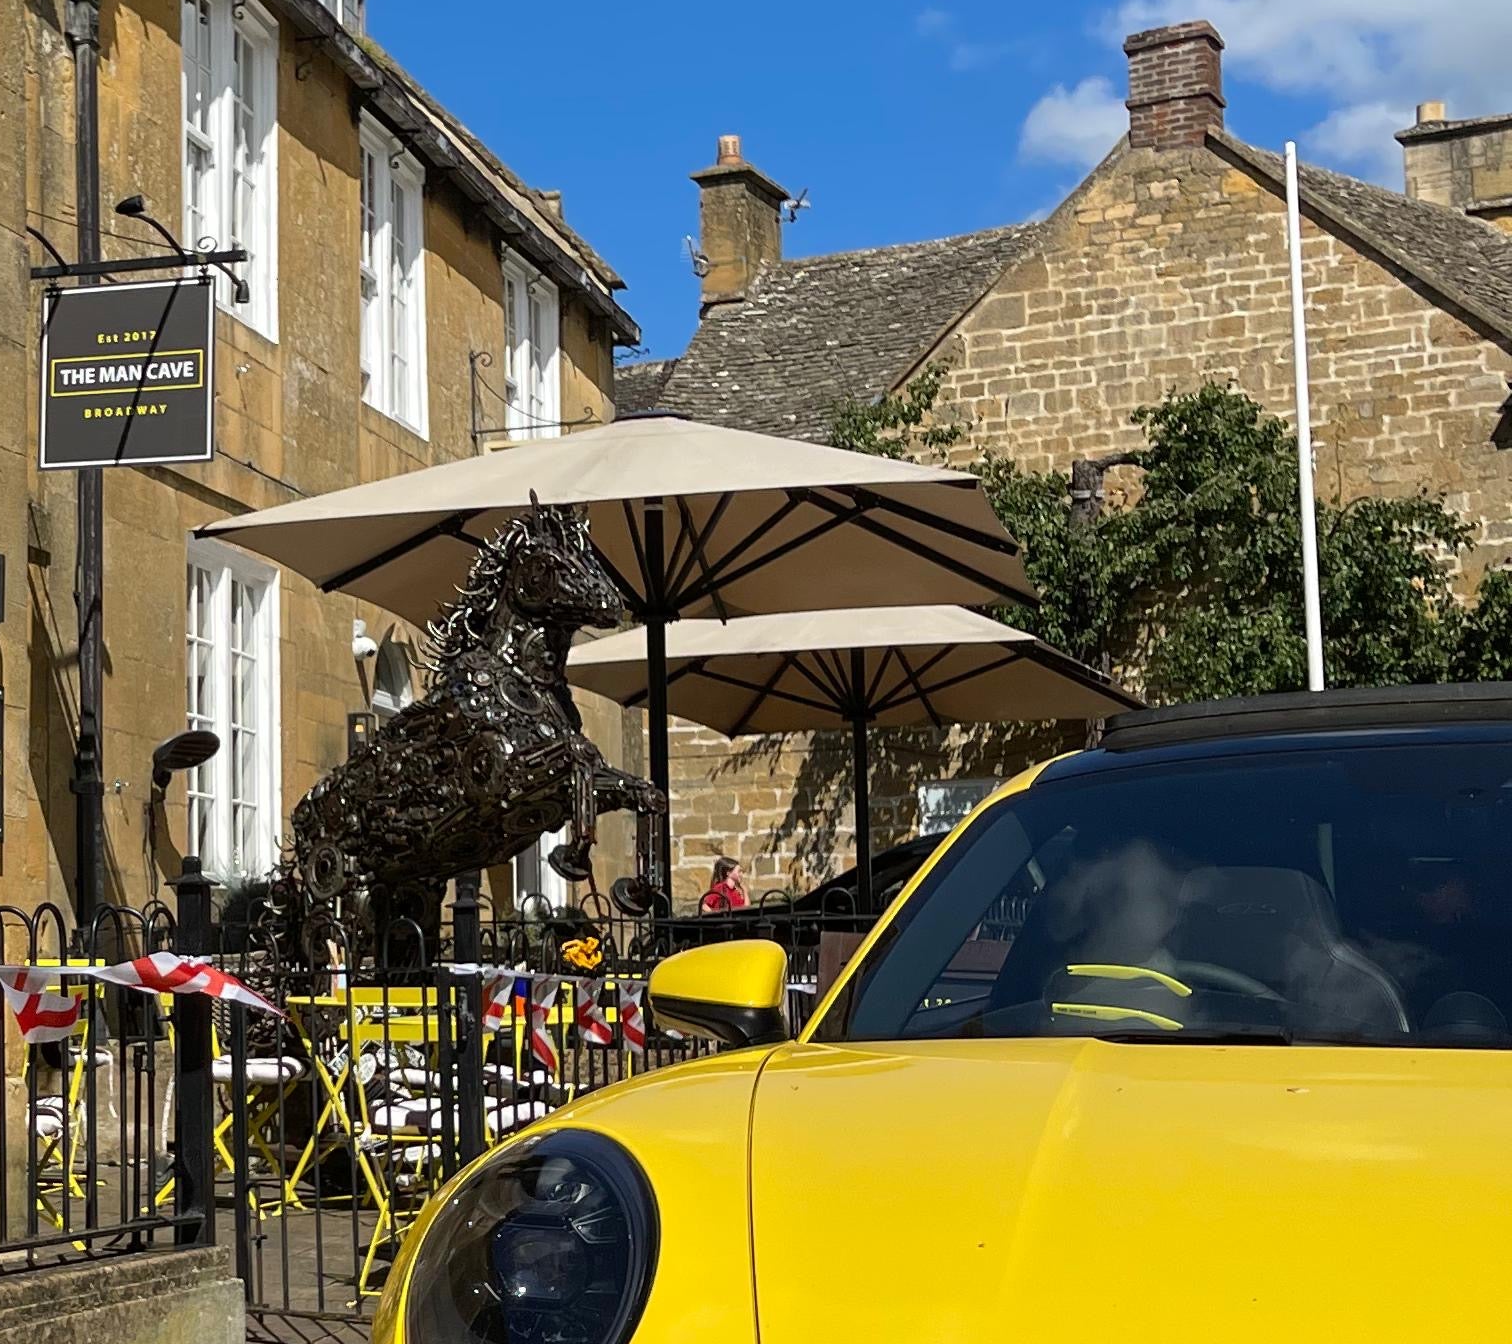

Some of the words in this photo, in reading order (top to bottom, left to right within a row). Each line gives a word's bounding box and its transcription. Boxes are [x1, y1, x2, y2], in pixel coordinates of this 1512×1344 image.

[97, 332, 119, 344] Est
[59, 367, 96, 386] THE
[98, 364, 143, 384] MAN
[146, 361, 195, 381] CAVE
